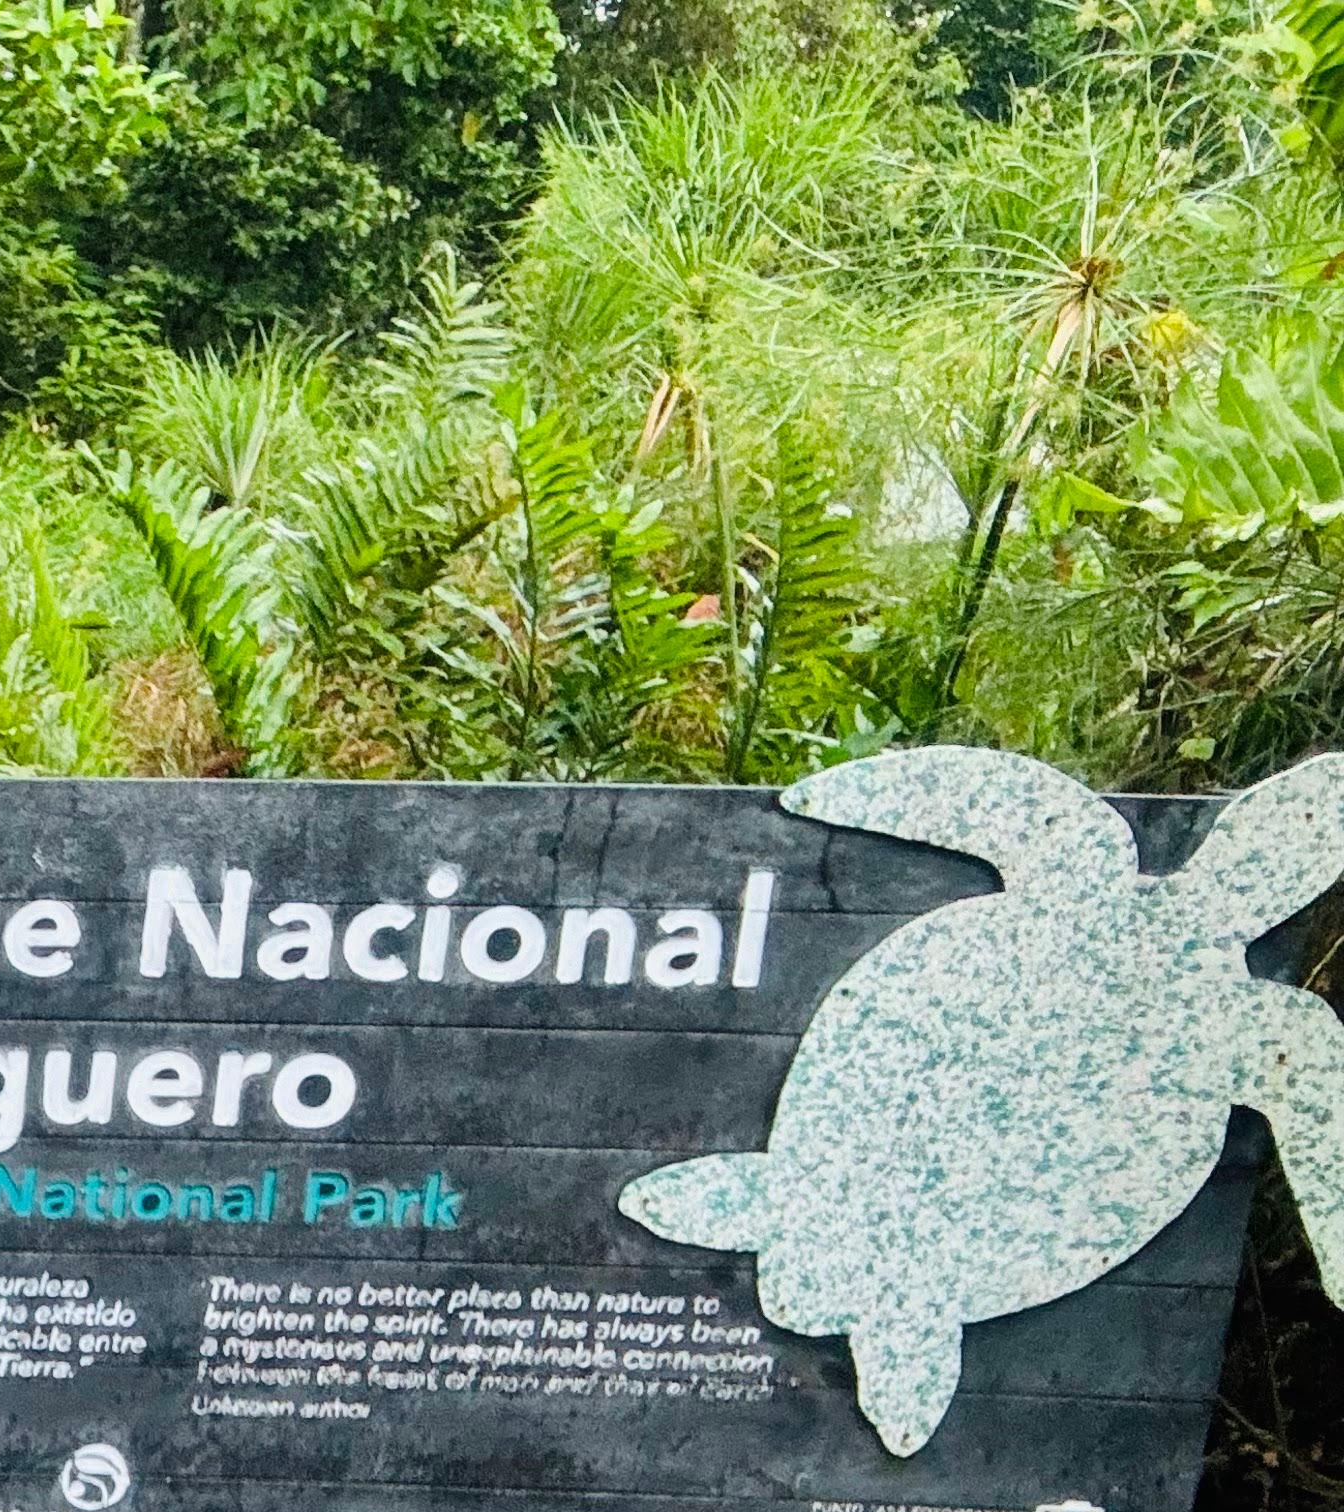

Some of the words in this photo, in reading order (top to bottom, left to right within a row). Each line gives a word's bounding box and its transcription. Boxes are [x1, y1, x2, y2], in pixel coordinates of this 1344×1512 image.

[139, 862, 776, 989] Nacional
[302, 1171, 466, 1230] Park
[34, 1299, 137, 1328] existido
[317, 1286, 353, 1305] no
[358, 1281, 445, 1307] better
[447, 1281, 522, 1314] place
[530, 1283, 591, 1312] than
[596, 1291, 685, 1315] nature
[693, 1294, 720, 1315] to
[203, 1303, 315, 1336] brighten
[324, 1308, 369, 1333] the
[459, 1311, 535, 1338] There
[541, 1314, 588, 1340] has
[593, 1316, 686, 1347] always
[691, 1319, 761, 1345] been
[78, 1333, 148, 1354] entre
[199, 1336, 219, 1357] a
[223, 1336, 367, 1363] mysterious
[372, 1337, 425, 1363] and
